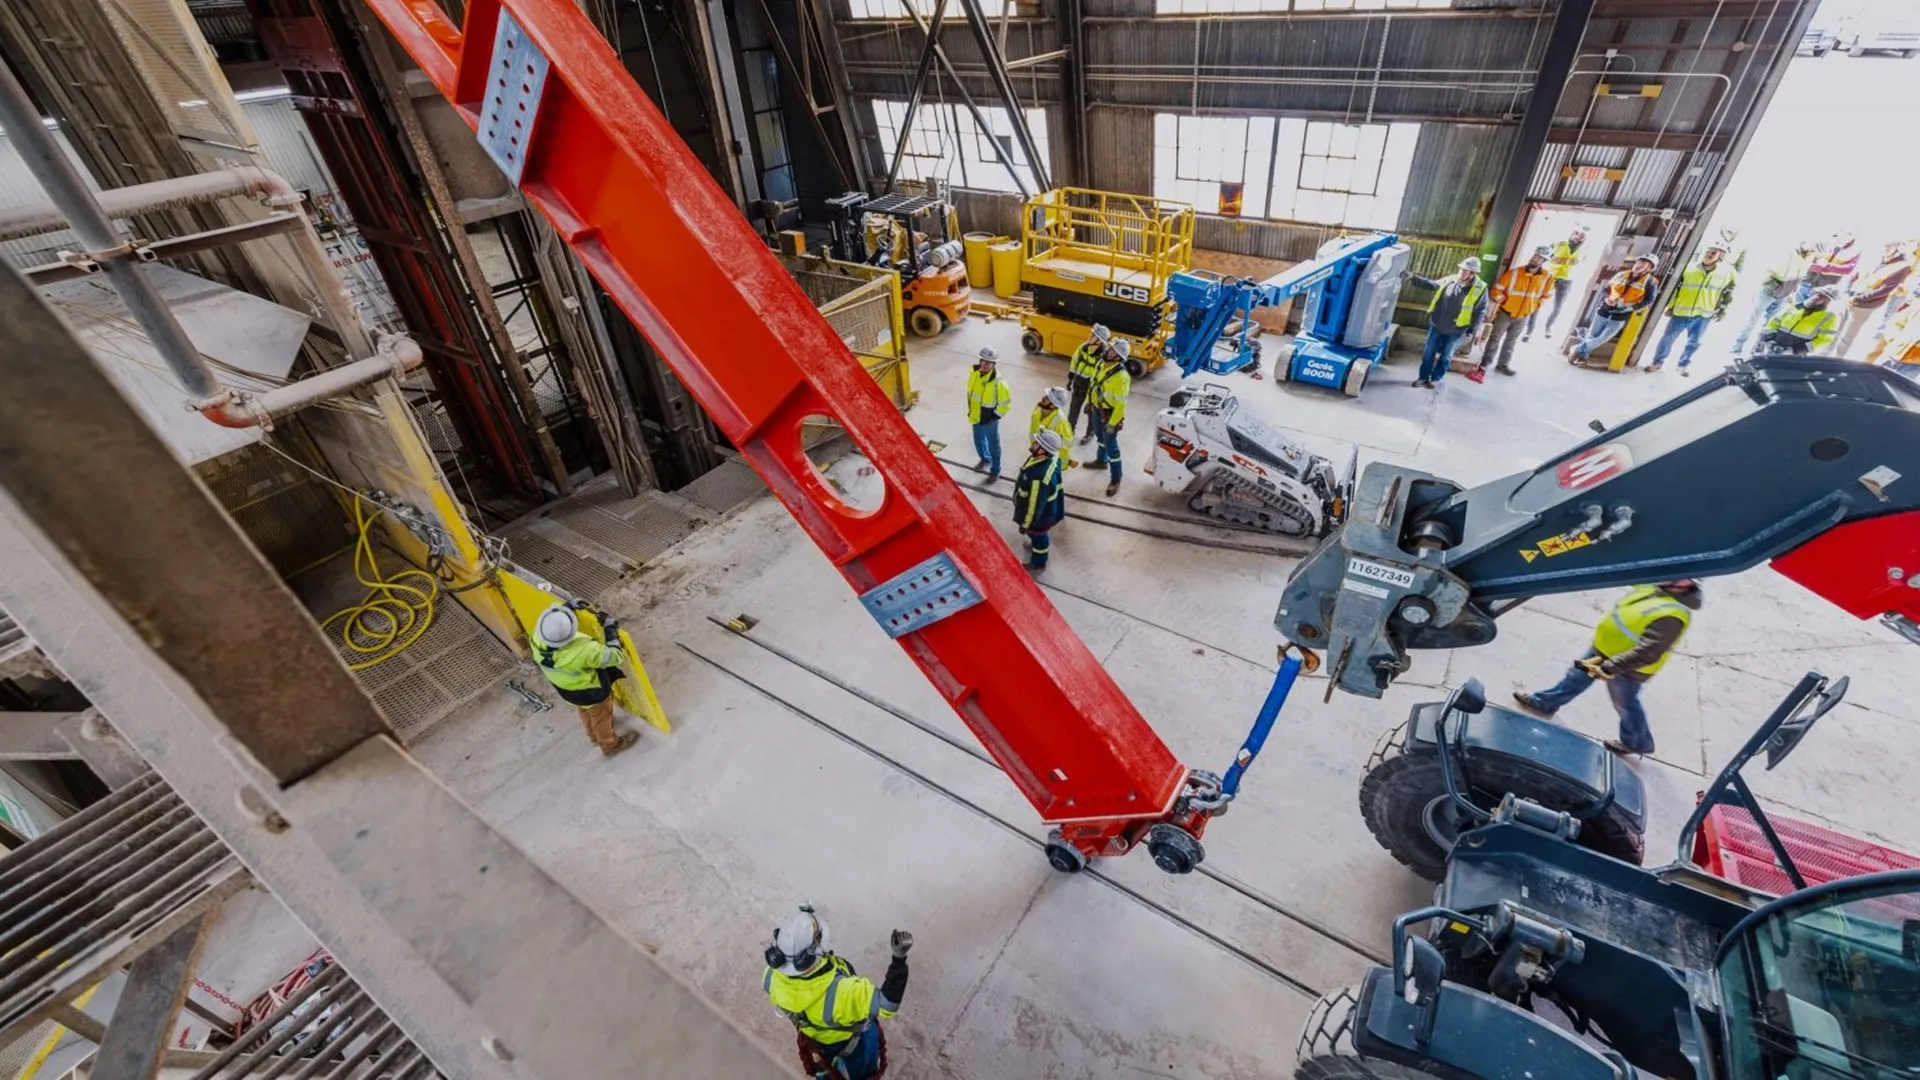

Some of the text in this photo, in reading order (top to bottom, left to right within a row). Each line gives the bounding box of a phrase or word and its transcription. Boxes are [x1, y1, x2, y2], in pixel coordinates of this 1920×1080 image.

[1105, 282, 1149, 303] JCB
[1302, 367, 1335, 380] BOOM
[1307, 359, 1334, 371] Genie
[1352, 561, 1411, 584] 11627349
